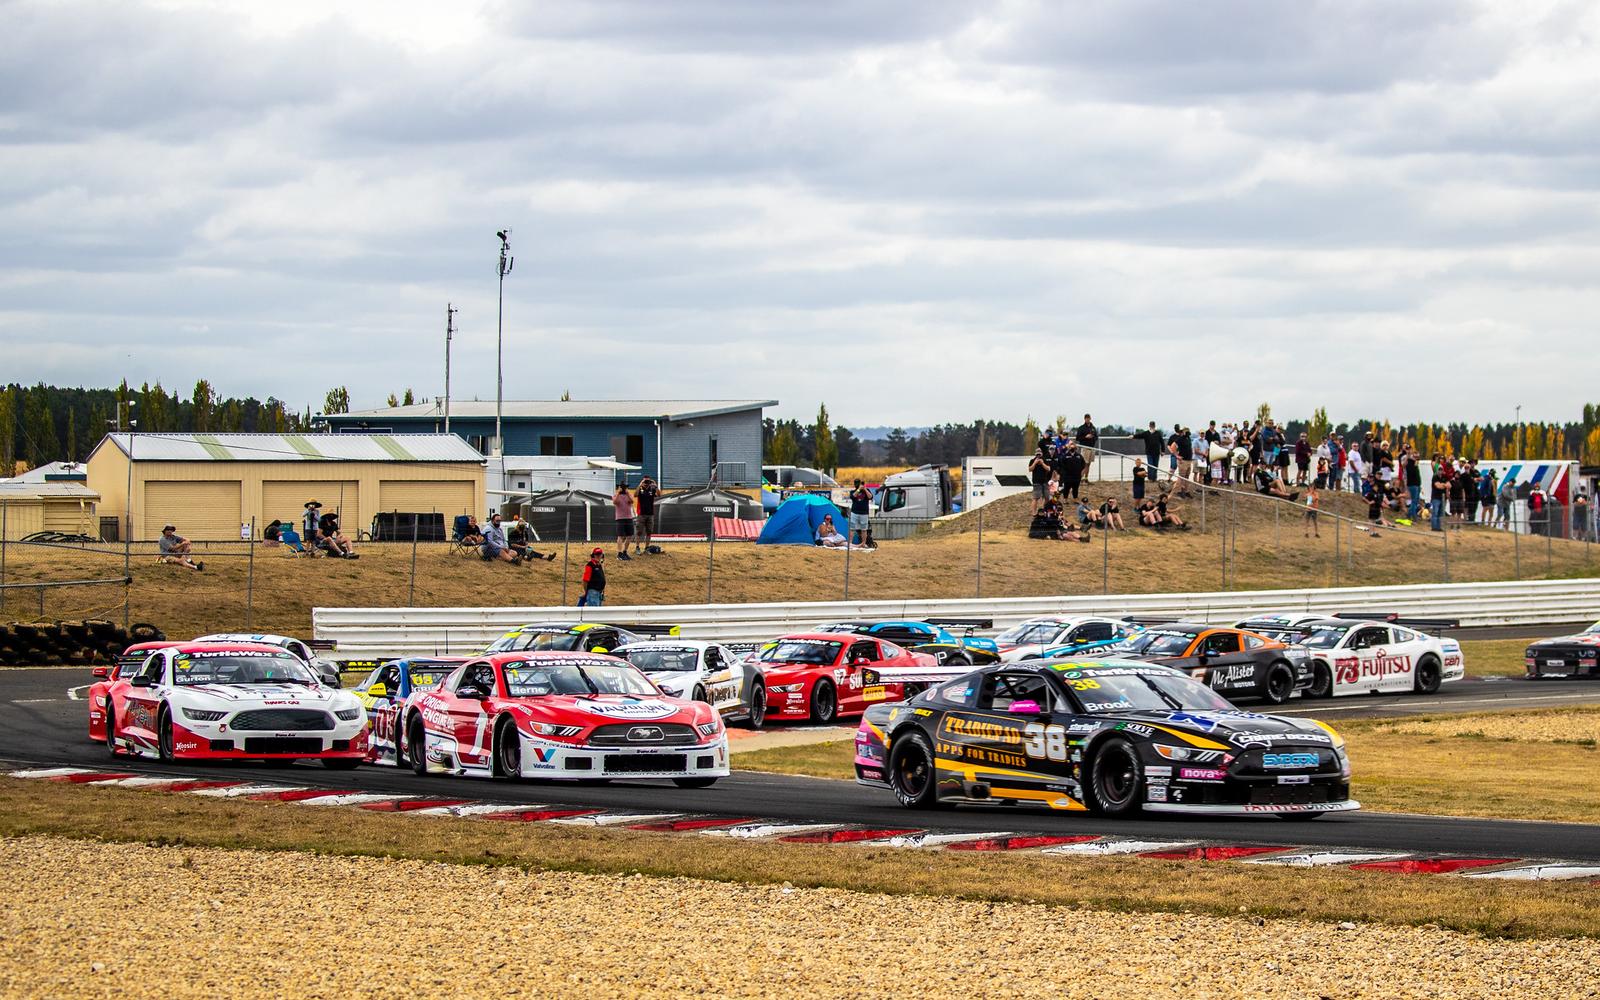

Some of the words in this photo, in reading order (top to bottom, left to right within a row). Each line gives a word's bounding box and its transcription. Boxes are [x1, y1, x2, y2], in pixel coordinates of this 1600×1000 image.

[192, 649, 273, 660] TurtleWax
[178, 659, 191, 672] 2
[525, 659, 612, 668] TurtleWax
[1362, 655, 1411, 682] FUJITSU
[833, 668, 847, 686] 67
[1082, 667, 1172, 678] TurtleWax
[1334, 656, 1359, 685] 73
[510, 685, 546, 695] Herne
[1070, 678, 1102, 691] 38
[1233, 681, 1256, 689] MOTORS
[864, 689, 885, 698] AUTO
[1084, 701, 1134, 711] Brook
[422, 708, 449, 727] ENGINE
[469, 712, 488, 756] 1
[944, 716, 1021, 745] TRADIEPAD
[1125, 721, 1156, 736] SOLVE
[175, 742, 198, 752] Hoosier
[1023, 722, 1067, 763] 38
[934, 742, 964, 757] APPS
[966, 748, 986, 762] FOR
[987, 752, 1028, 768] TRADIES
[1184, 768, 1215, 778] nova
